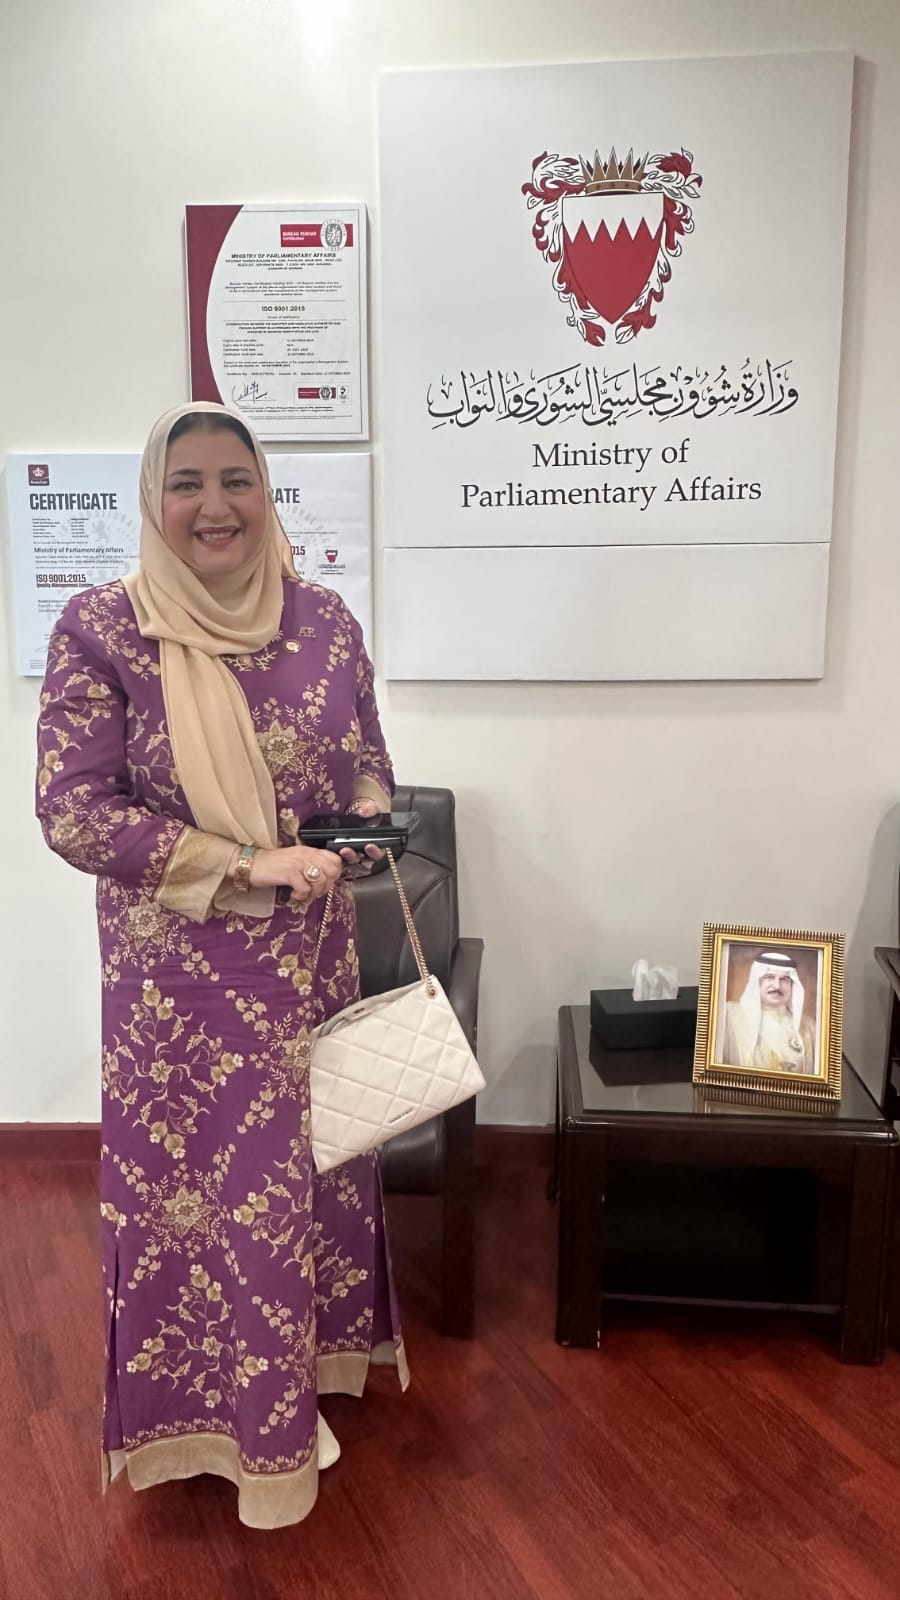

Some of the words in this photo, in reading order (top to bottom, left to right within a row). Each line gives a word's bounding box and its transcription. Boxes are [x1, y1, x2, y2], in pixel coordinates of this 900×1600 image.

[734, 354, 799, 418] وزارة
[532, 442, 652, 473] Ministry
[661, 438, 690, 464] of
[29, 493, 117, 511] CERTIFICATE
[461, 482, 657, 511] Parliamentary
[664, 476, 762, 502] Affairs
[34, 547, 57, 555] Ministry
[36, 574, 48, 583] ISO
[49, 573, 87, 583] 9001:2015
